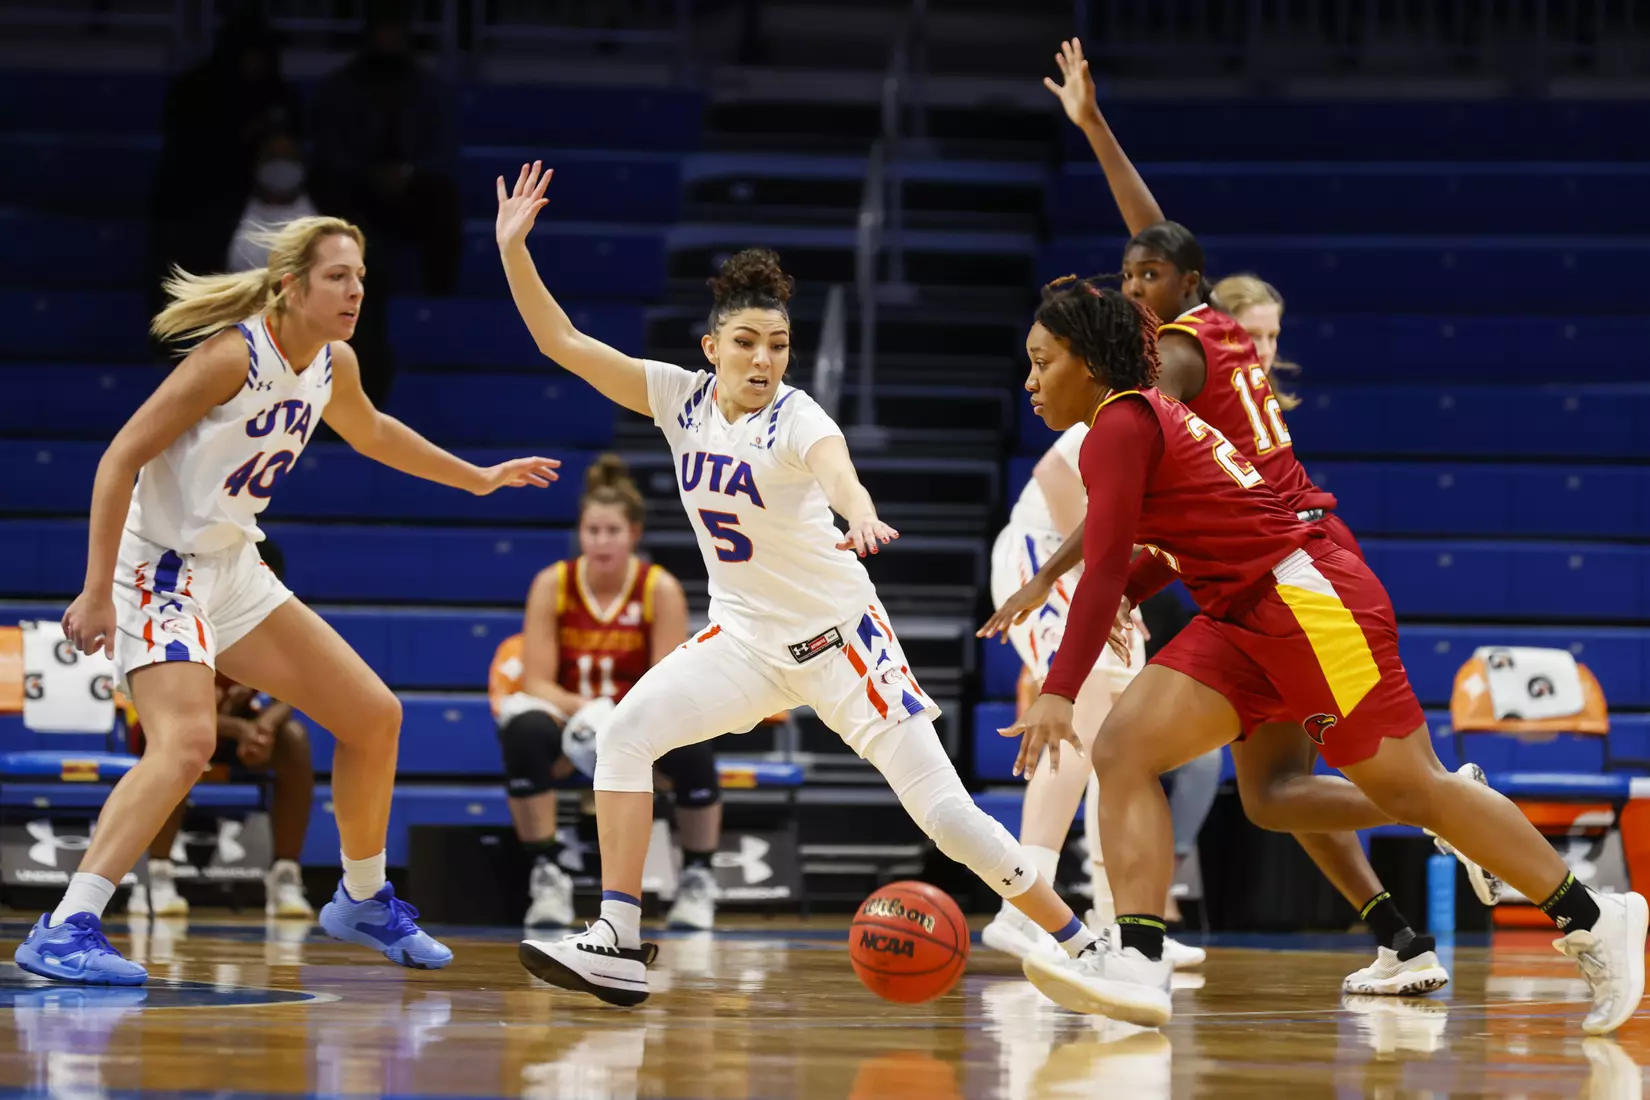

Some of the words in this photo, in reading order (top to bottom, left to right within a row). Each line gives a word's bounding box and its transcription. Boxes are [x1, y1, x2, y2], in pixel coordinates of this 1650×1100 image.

[246, 399, 312, 445] UTA
[1231, 364, 1293, 455] 12
[223, 449, 295, 498] 40
[1184, 412, 1265, 489] 2
[681, 451, 766, 510] UTA
[697, 508, 754, 563] 5
[577, 654, 618, 698] 11
[862, 898, 936, 934] Wilson
[860, 931, 915, 958] NCAA
